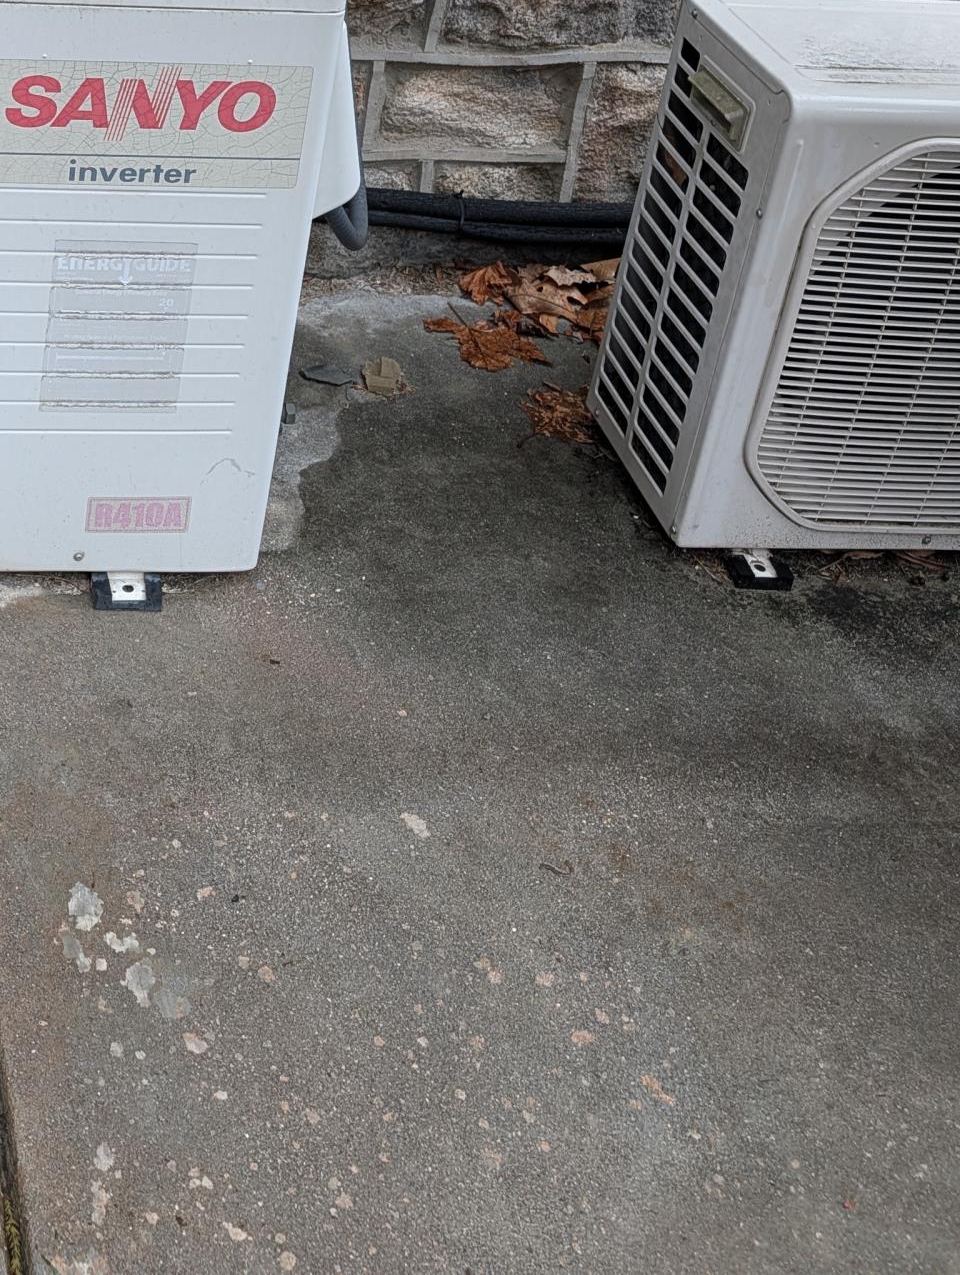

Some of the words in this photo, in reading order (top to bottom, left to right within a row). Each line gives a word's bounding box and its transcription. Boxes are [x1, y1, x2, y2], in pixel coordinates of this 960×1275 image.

[5, 67, 277, 141] SANYO
[68, 159, 197, 184] inverter
[95, 503, 182, 527] R410A
